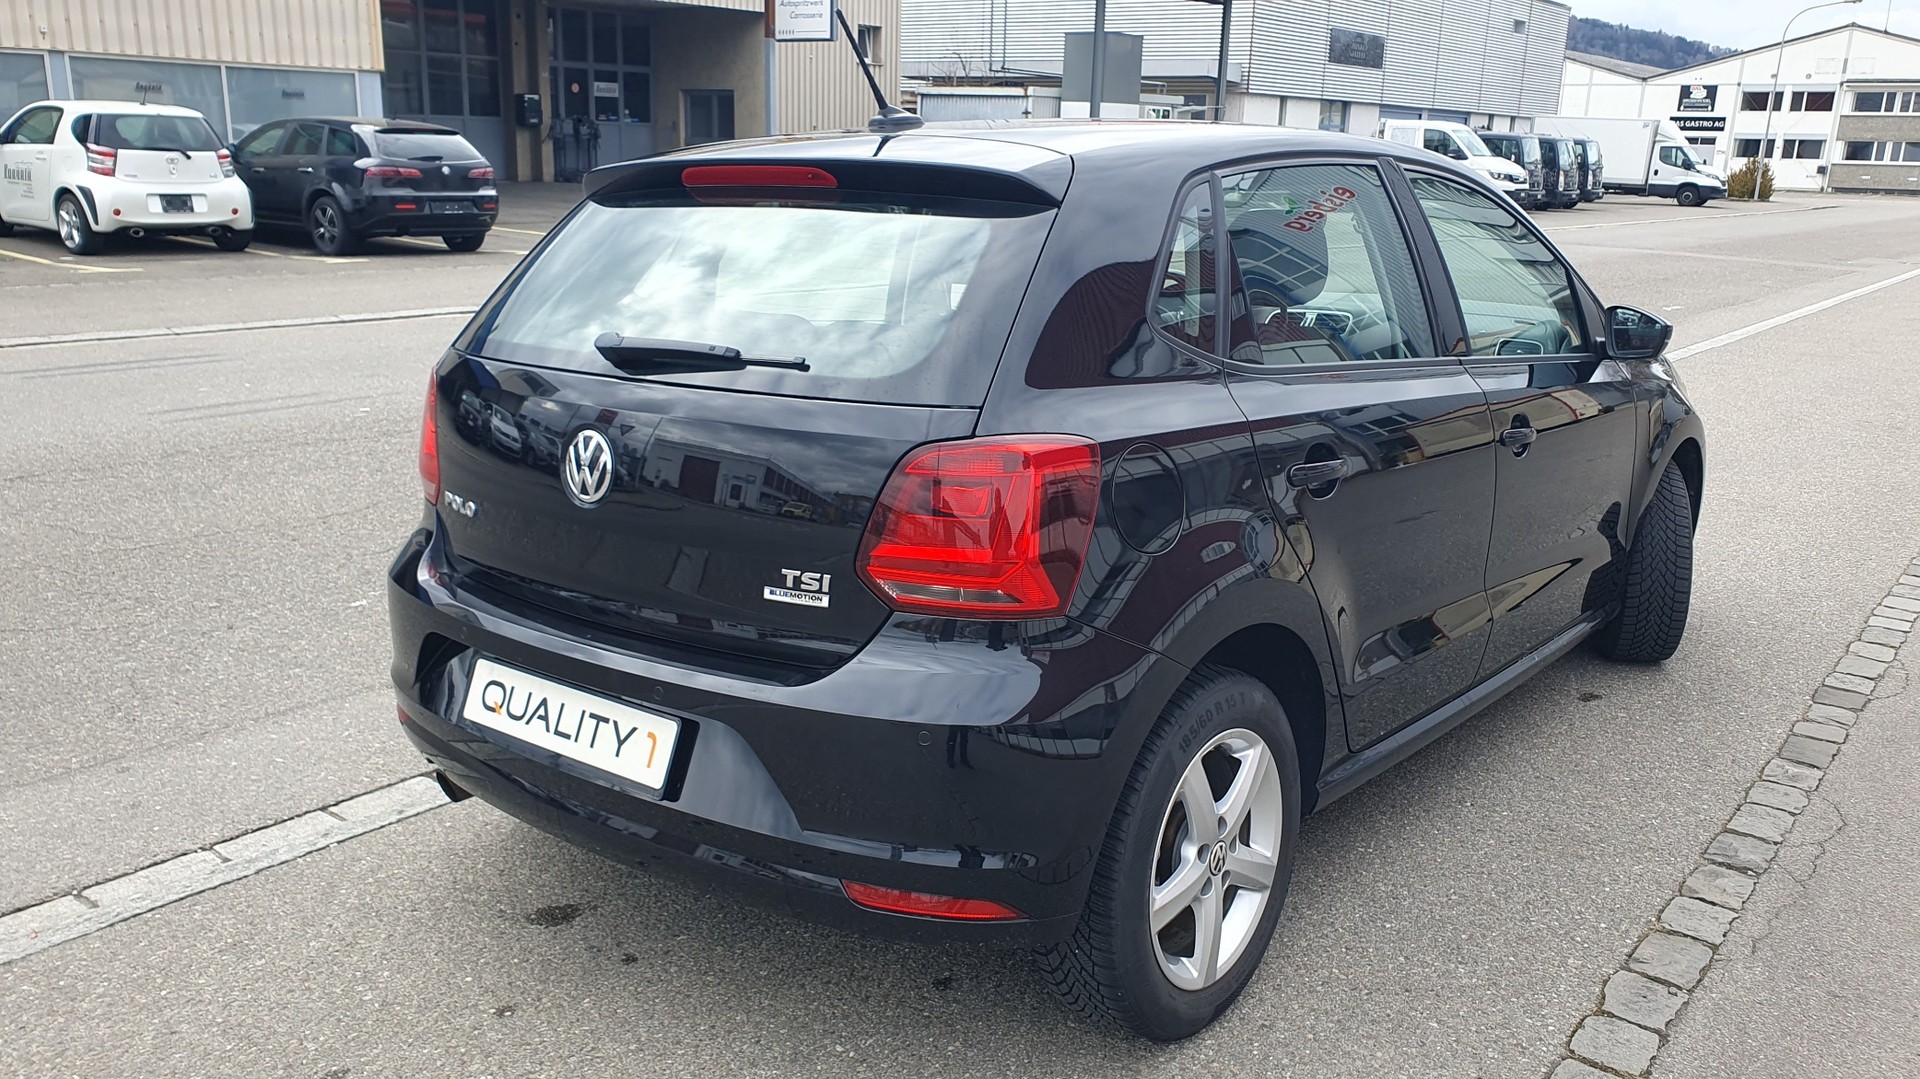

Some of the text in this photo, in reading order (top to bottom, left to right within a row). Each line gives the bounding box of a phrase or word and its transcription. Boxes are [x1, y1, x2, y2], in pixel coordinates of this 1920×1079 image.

[789, 11, 824, 19] Carrosserie
[1685, 120, 1713, 128] GASTRO
[1713, 120, 1725, 128] AG
[444, 490, 475, 517] POLO
[781, 568, 831, 593] TSI
[769, 589, 823, 602] BLUEMOTION
[482, 679, 657, 769] QUALITY 1
[1179, 708, 1213, 753] 185/60
[1213, 701, 1224, 716] R
[1225, 693, 1237, 711] 15
